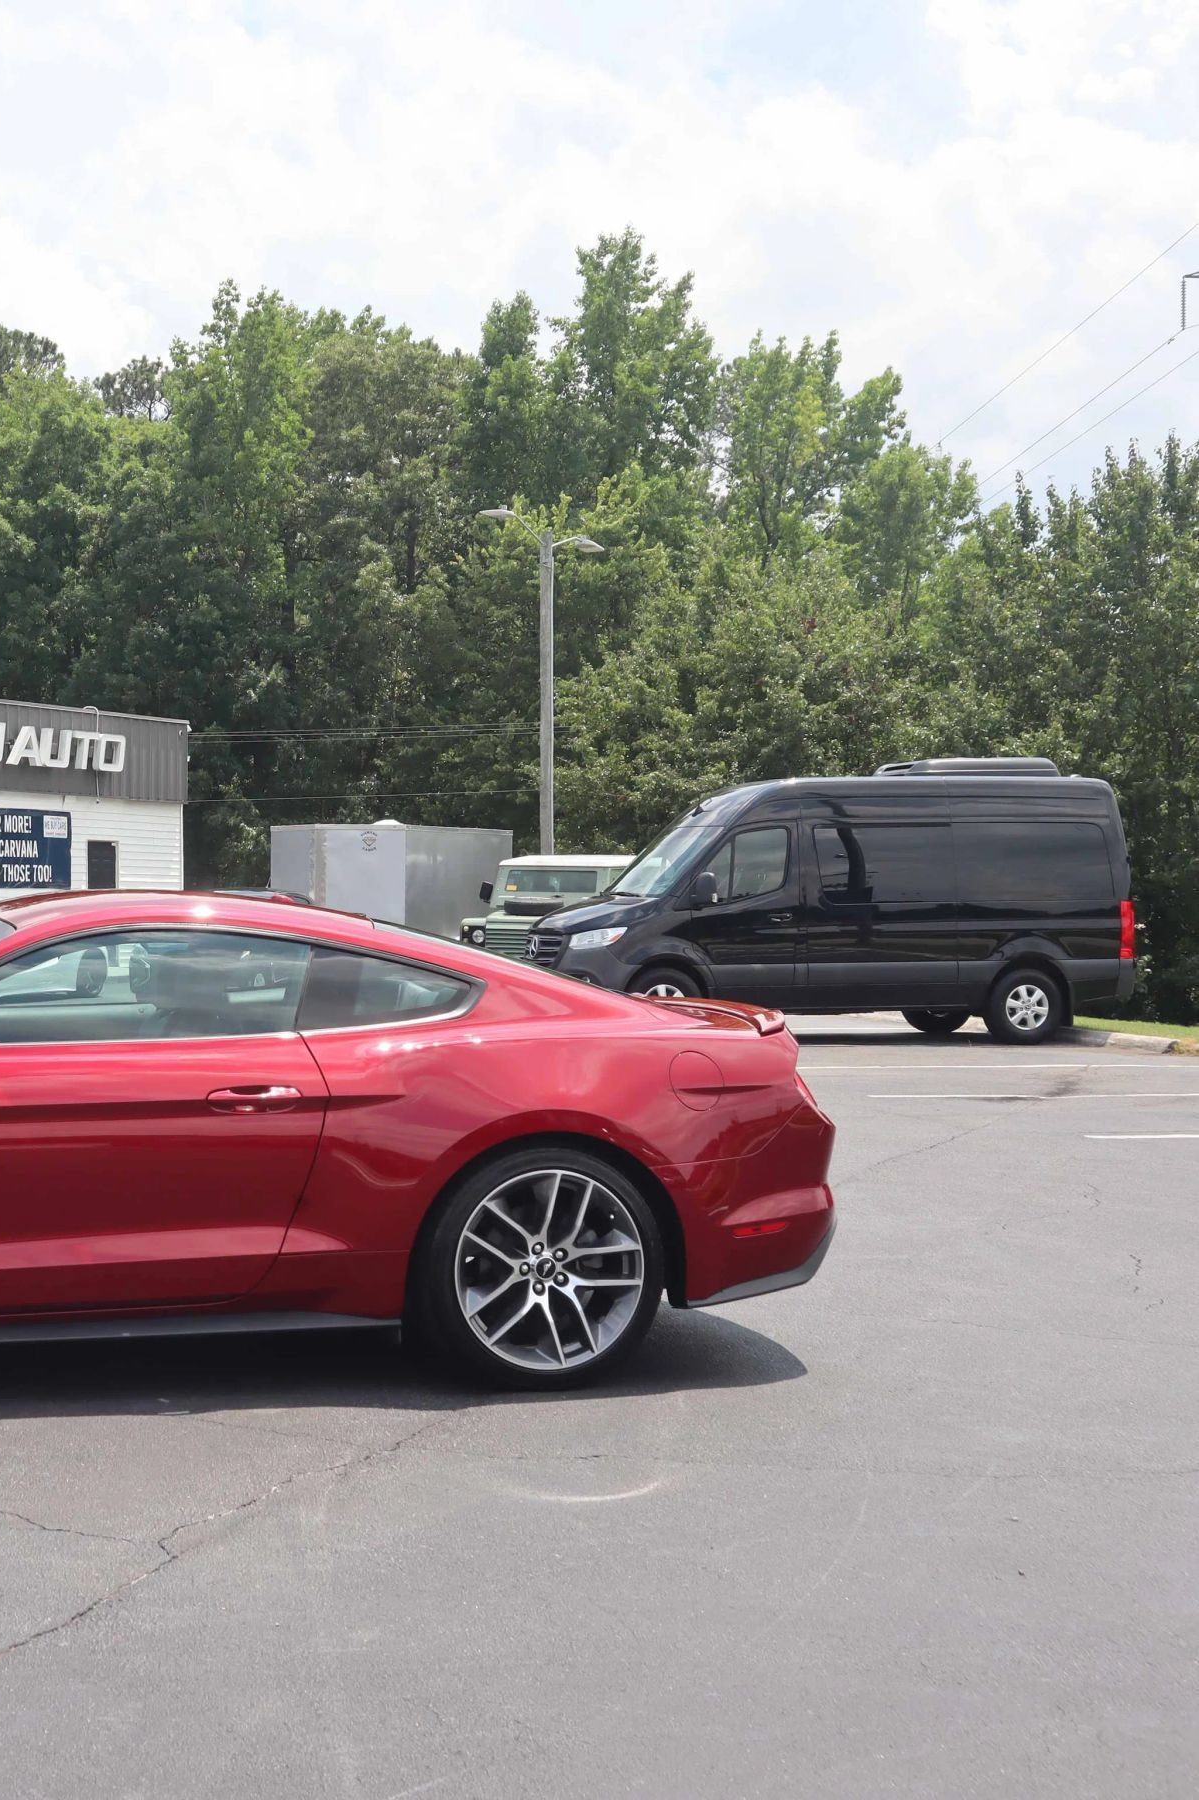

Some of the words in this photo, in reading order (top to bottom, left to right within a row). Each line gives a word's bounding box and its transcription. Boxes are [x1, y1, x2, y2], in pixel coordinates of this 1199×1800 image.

[5, 725, 127, 773] AUTO
[4, 815, 32, 834] MORE!
[2, 864, 31, 882] THOSE
[32, 865, 53, 883] TOO!
